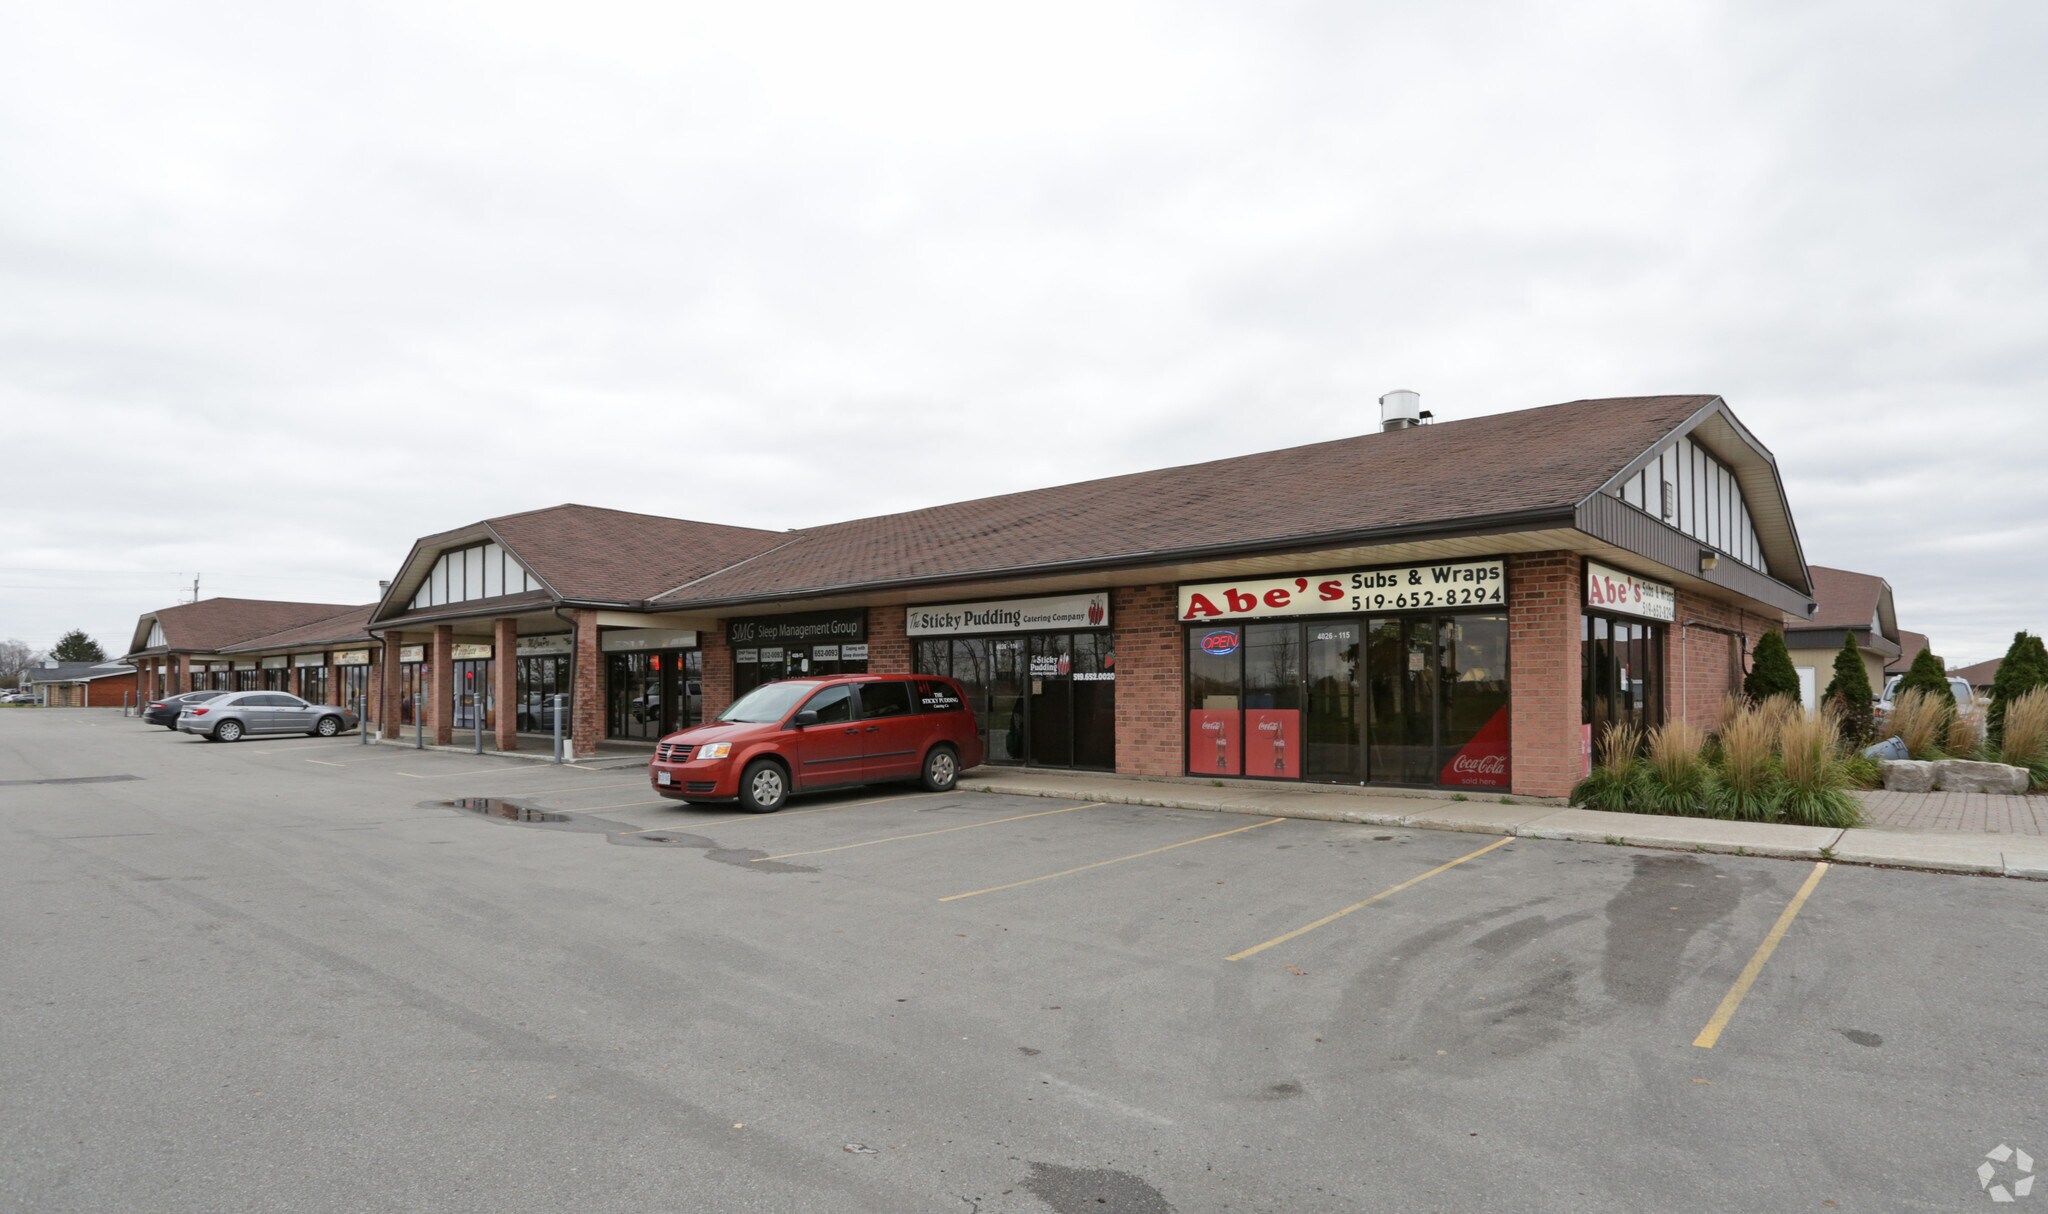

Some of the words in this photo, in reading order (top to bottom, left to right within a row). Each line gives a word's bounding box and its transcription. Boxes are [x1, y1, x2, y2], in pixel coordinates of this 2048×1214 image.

[1351, 572, 1398, 589] Subs
[1408, 569, 1422, 585] &
[1431, 566, 1500, 584] Wraps
[1183, 578, 1344, 619] Abe's
[1351, 587, 1501, 610] 519-652-8294
[1589, 575, 1641, 604] Abe's
[921, 612, 961, 630] Sticky
[963, 609, 1021, 627] Pudding
[1023, 614, 1051, 623] Catering
[1052, 613, 1085, 622] Company
[732, 623, 755, 641] SMG
[758, 625, 778, 639] Sleep
[779, 622, 830, 639] Management
[831, 620, 858, 636] Group
[1338, 631, 1351, 639] 115
[1203, 634, 1239, 650] OPEN
[1030, 664, 1058, 672] Pudding
[1036, 655, 1058, 664] Sticky
[1479, 778, 1496, 786] here
